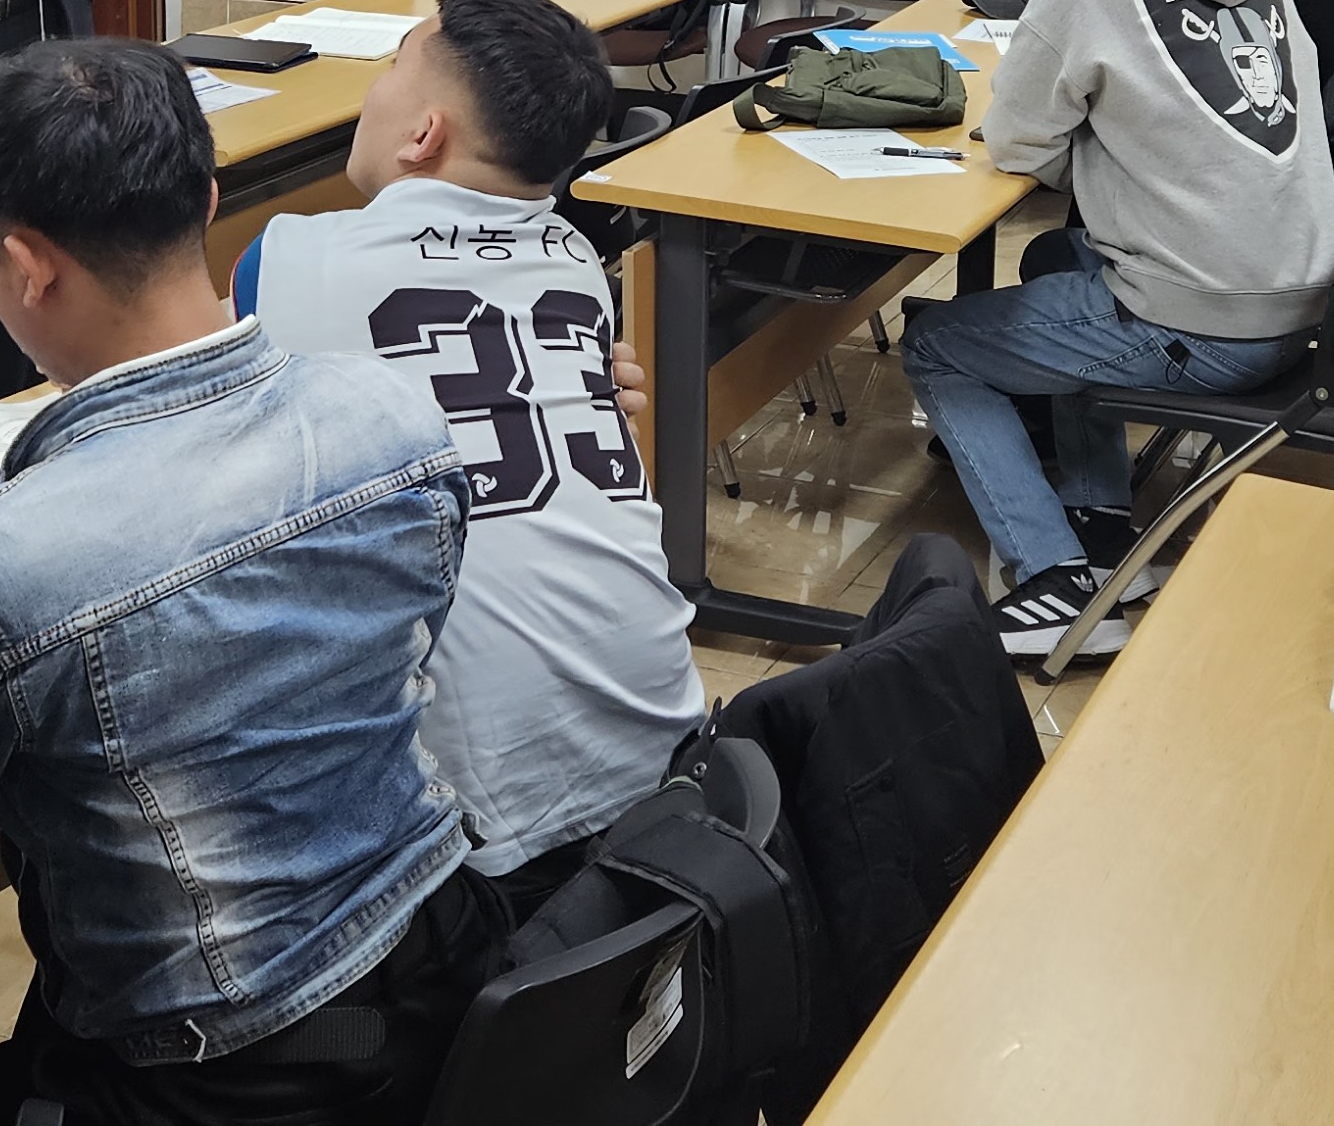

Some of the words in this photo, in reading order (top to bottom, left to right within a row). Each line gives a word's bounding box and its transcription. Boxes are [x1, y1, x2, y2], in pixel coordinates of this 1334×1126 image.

[410, 223, 517, 262] 신농
[541, 224, 588, 264] FC
[367, 287, 648, 522] 33
